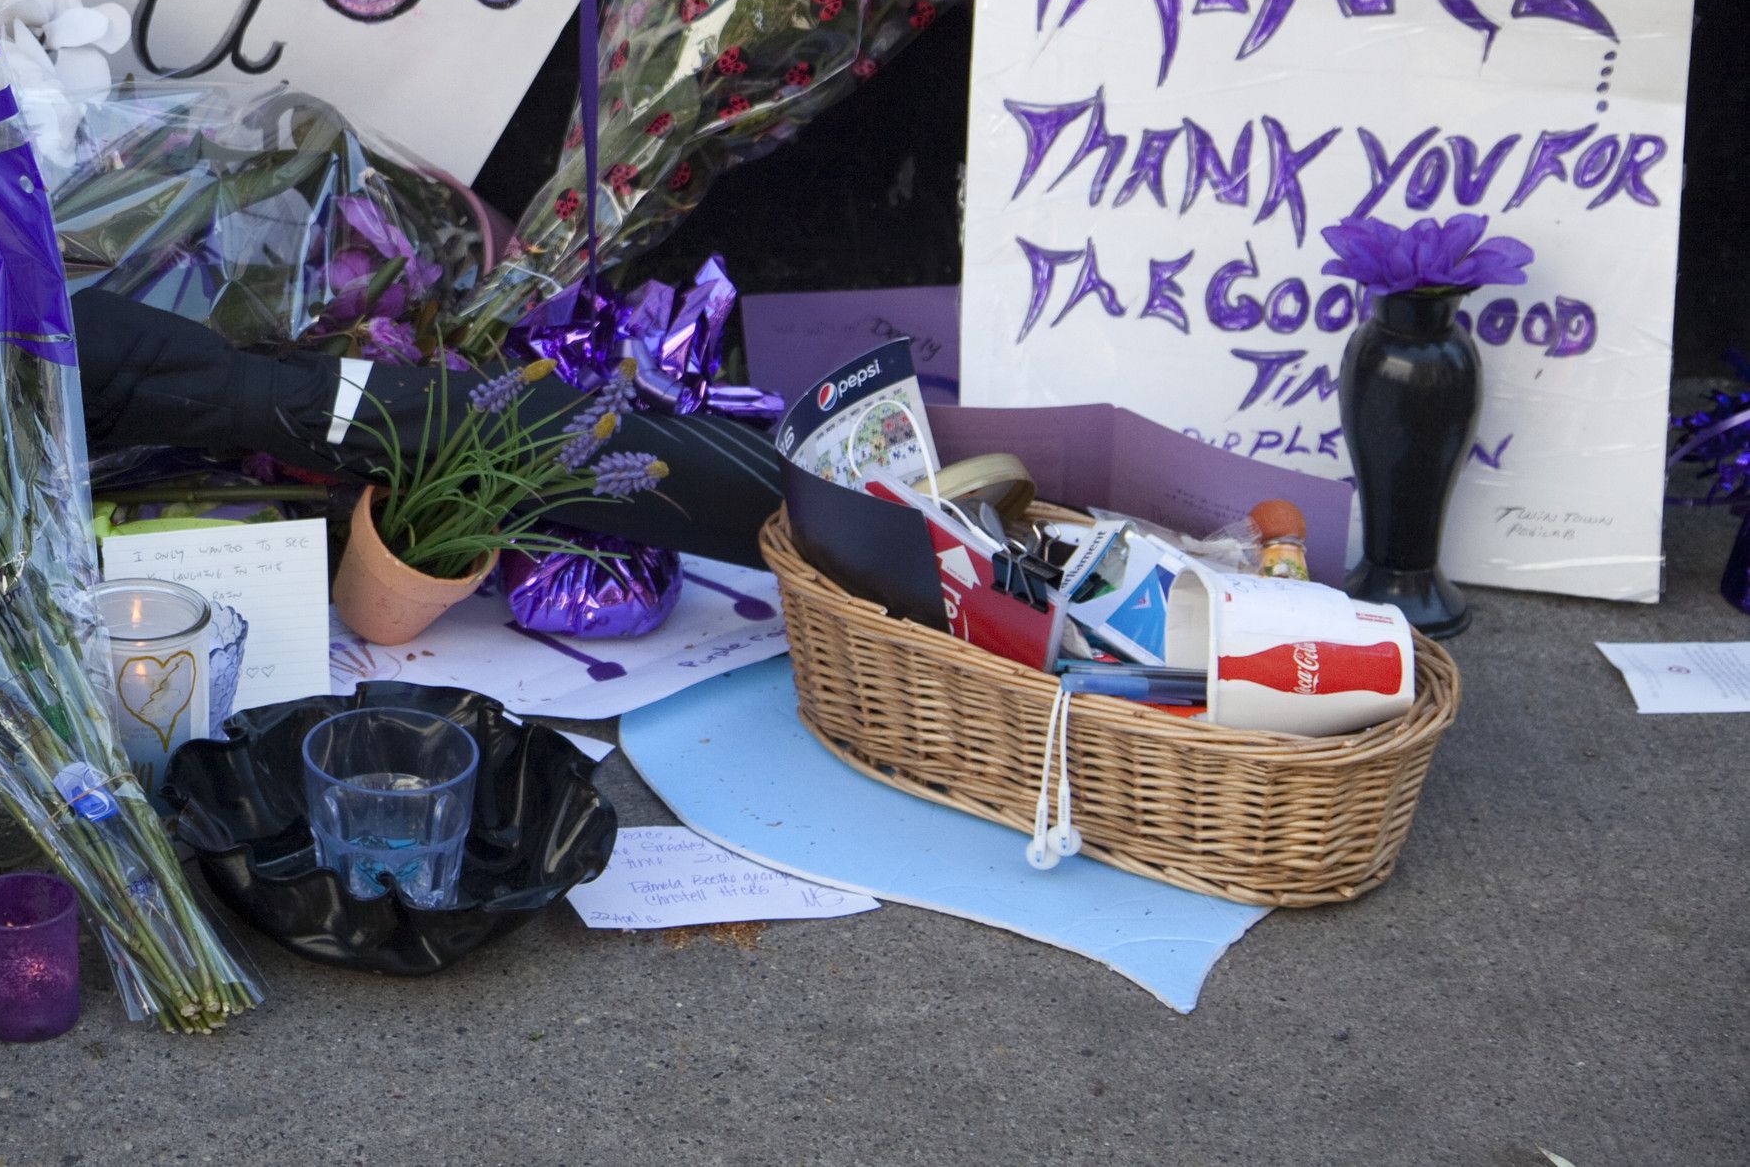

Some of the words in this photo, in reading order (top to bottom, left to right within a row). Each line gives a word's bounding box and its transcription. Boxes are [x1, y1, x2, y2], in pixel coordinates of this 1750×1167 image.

[1357, 125, 1521, 220] YOU
[1501, 122, 1668, 213] FOR
[1454, 296, 1597, 357] OOD
[837, 359, 882, 398] pepsi
[134, 552, 143, 562] I
[155, 549, 184, 563] ONLY
[258, 538, 271, 552] TO
[1061, 528, 1106, 591] arliament
